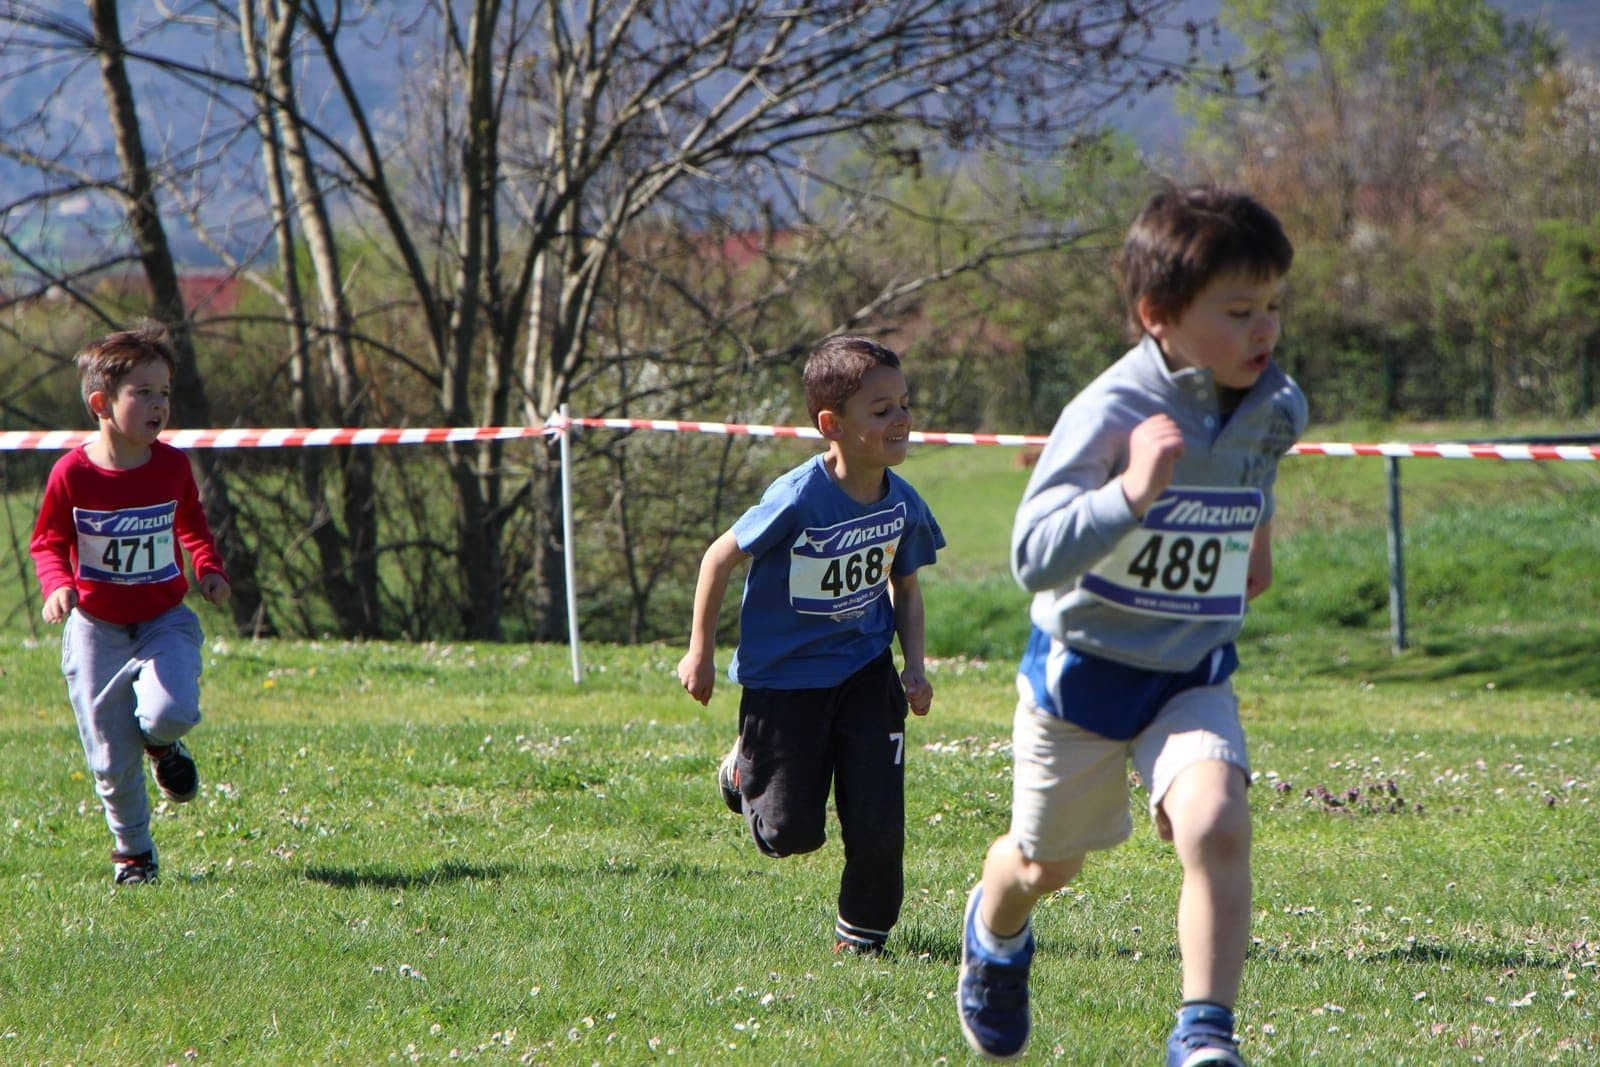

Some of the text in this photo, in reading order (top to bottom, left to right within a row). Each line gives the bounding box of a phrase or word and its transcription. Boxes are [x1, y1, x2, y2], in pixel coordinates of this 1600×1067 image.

[102, 535, 155, 573] 471
[821, 546, 884, 597] 468
[1127, 534, 1222, 593] 489
[889, 732, 904, 765] 7
